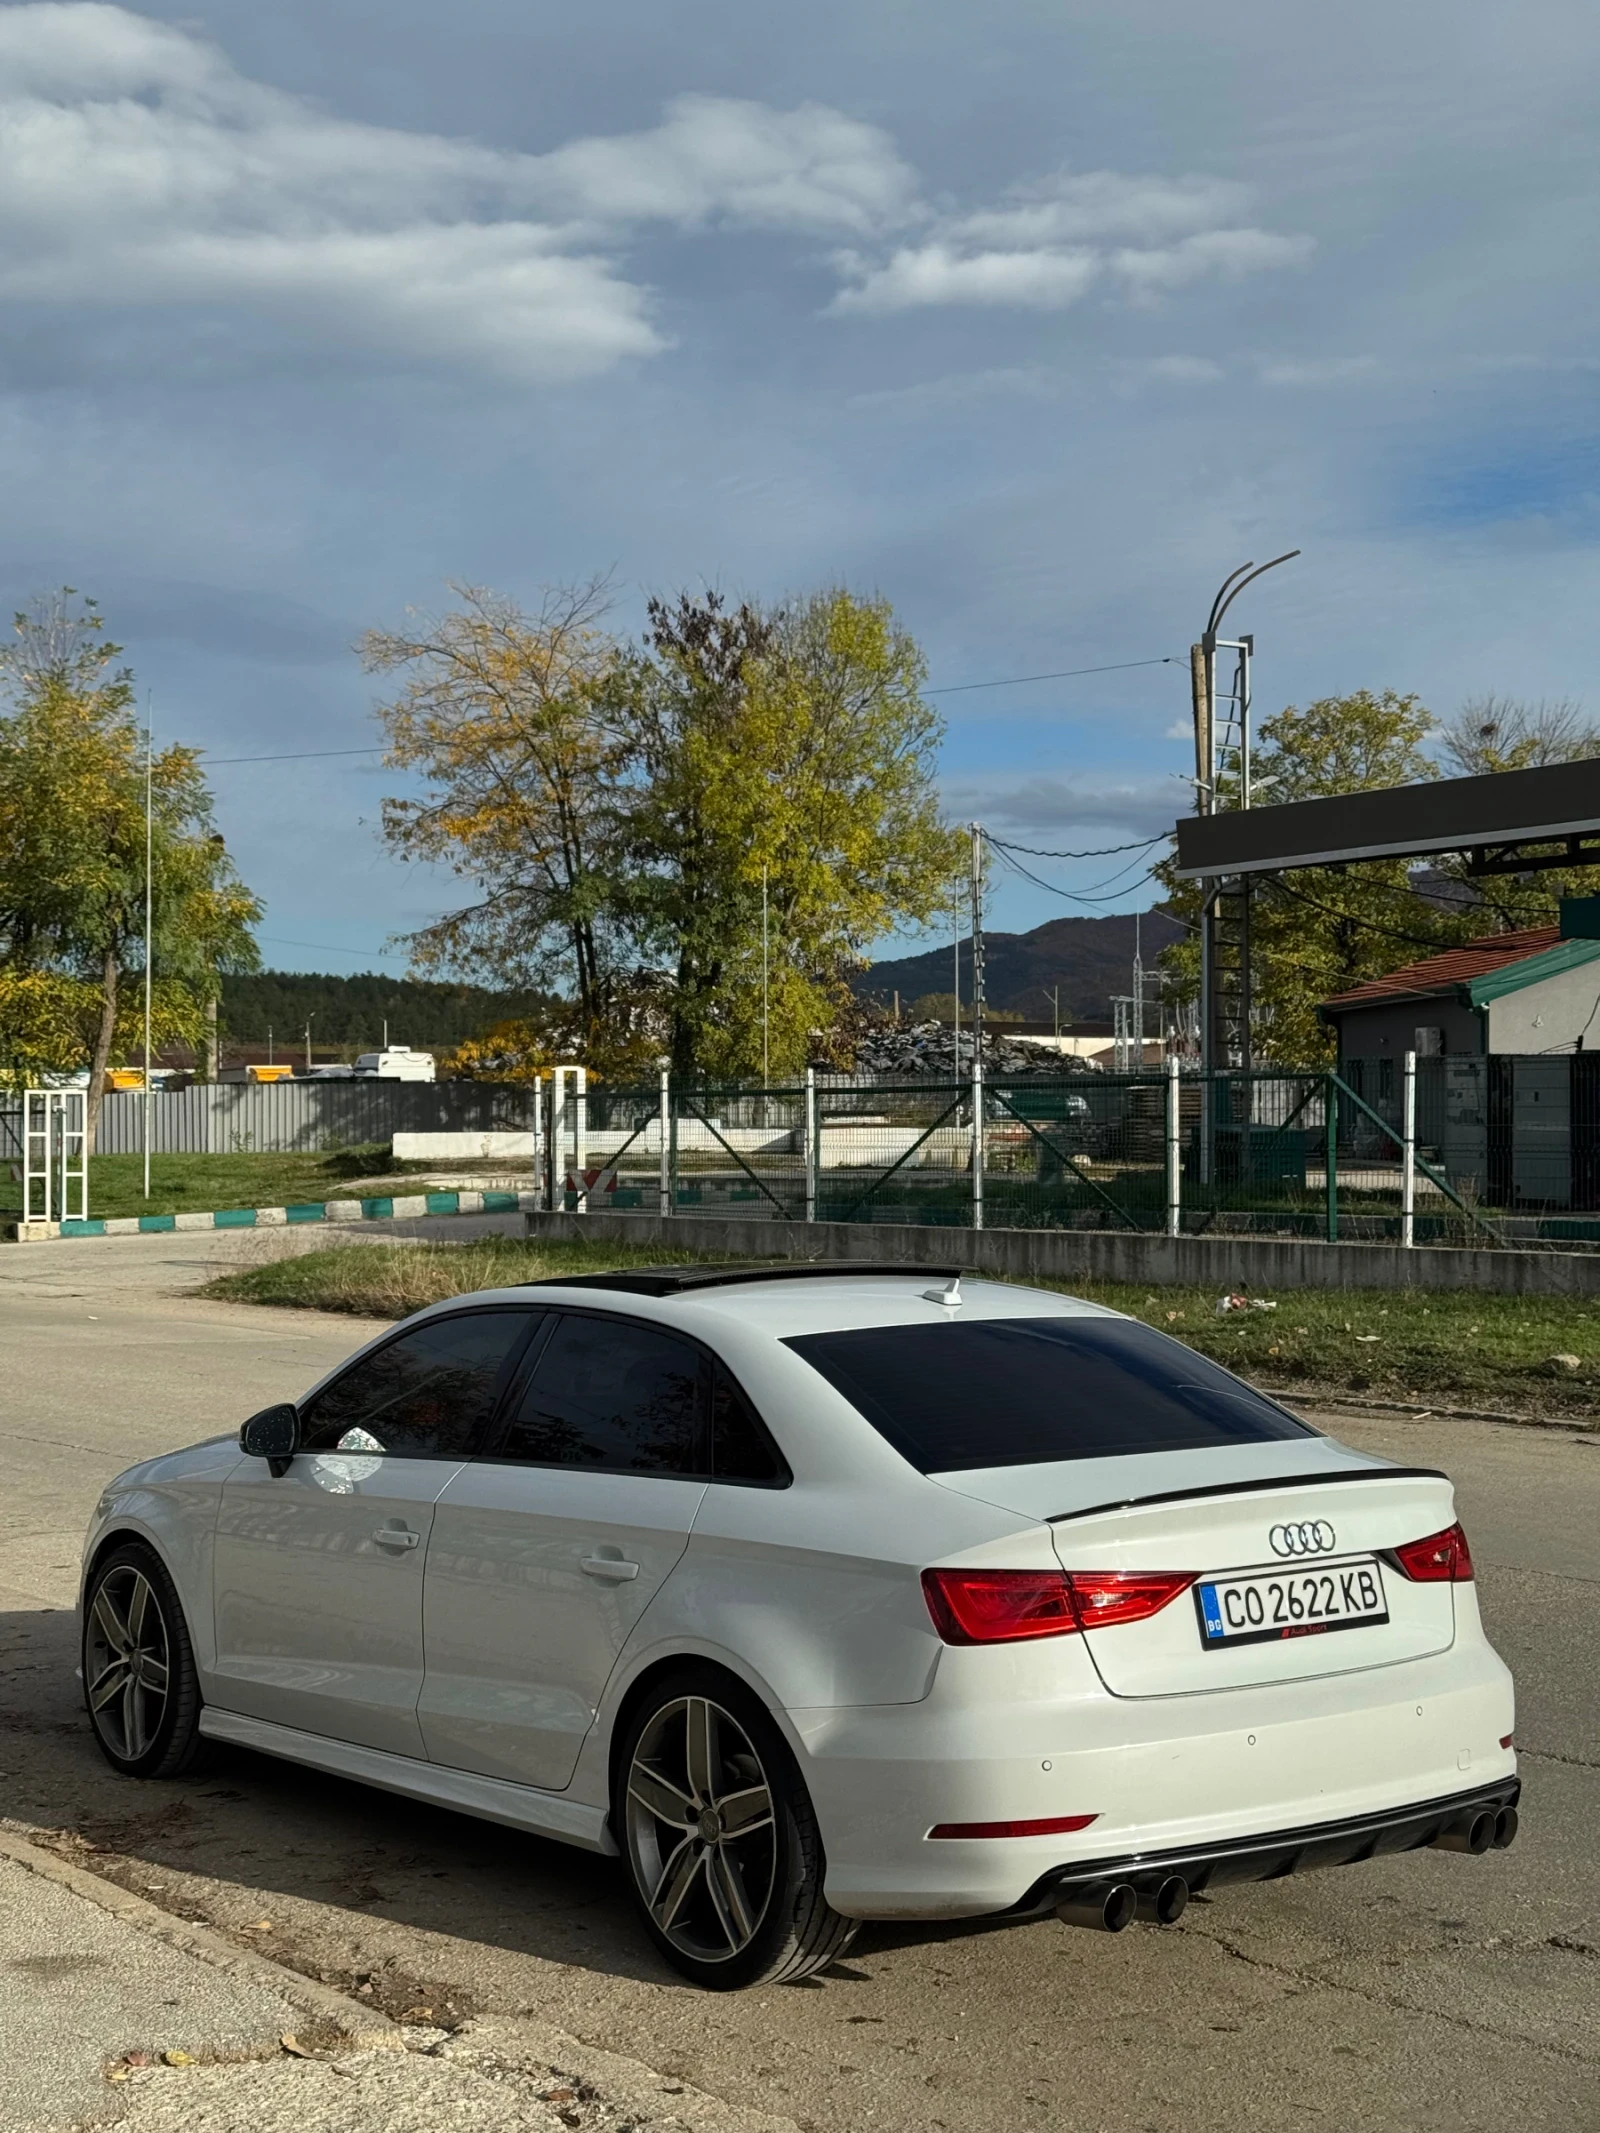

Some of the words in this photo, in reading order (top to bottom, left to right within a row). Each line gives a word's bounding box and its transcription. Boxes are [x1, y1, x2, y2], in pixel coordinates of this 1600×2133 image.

[1224, 1586, 1264, 1628] CO
[1268, 1576, 1340, 1623] 2622
[1340, 1571, 1378, 1613] KB
[1207, 1619, 1222, 1632] BG
[1290, 1626, 1307, 1635] Audi
[1307, 1623, 1328, 1633] Sport
